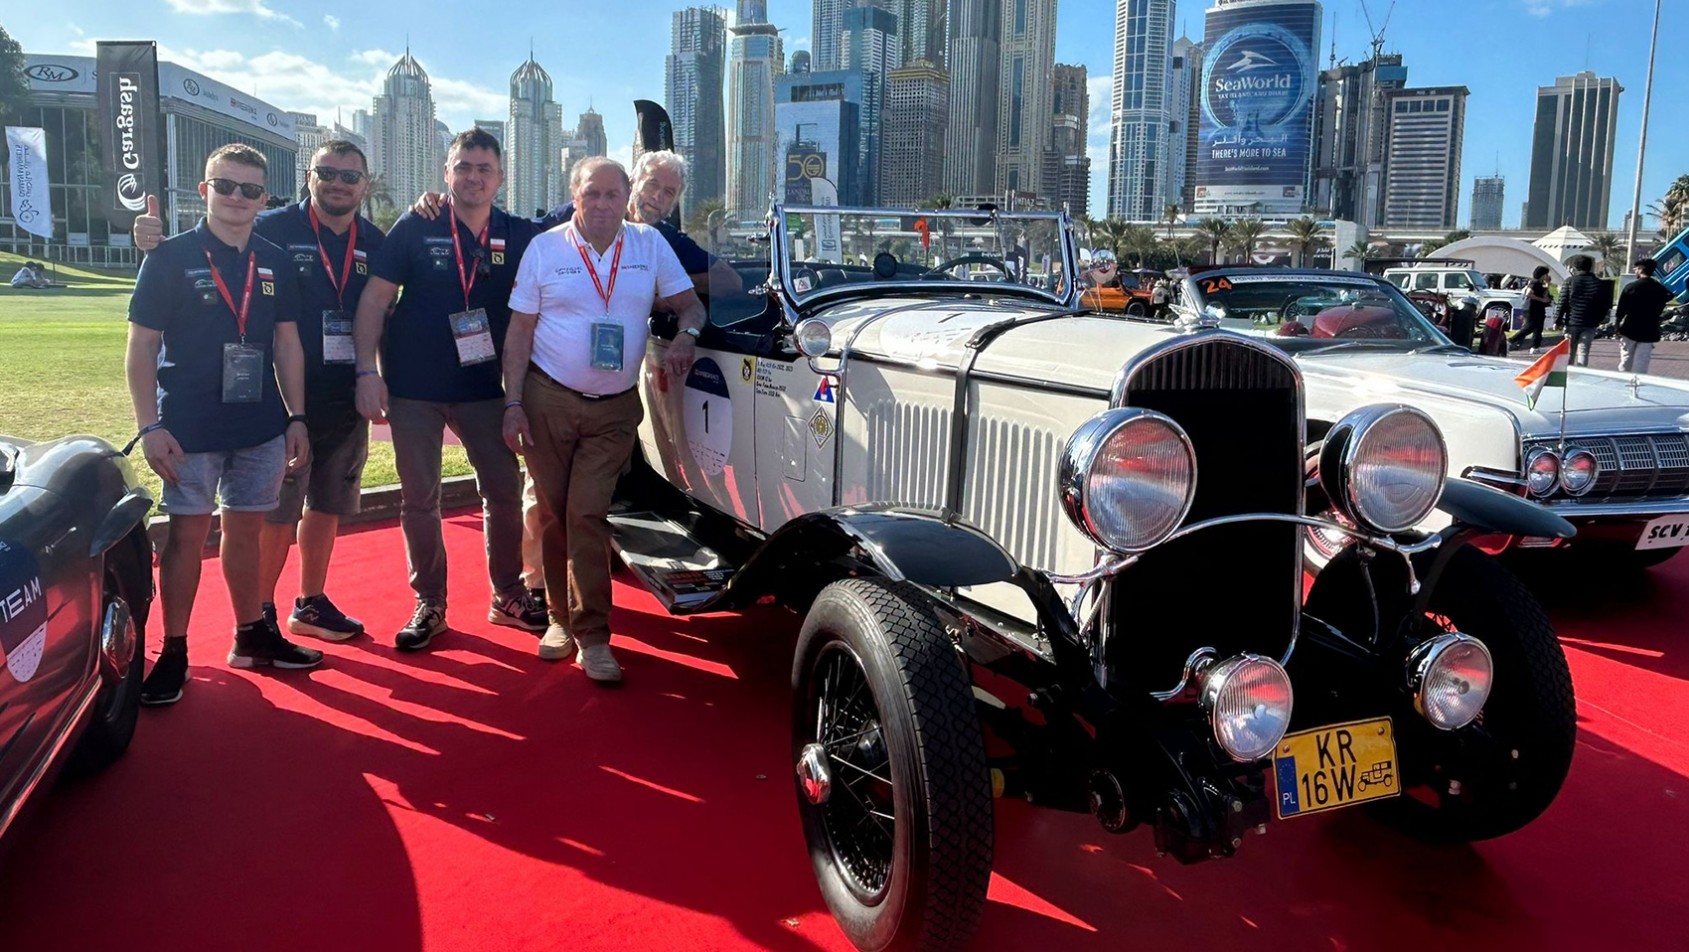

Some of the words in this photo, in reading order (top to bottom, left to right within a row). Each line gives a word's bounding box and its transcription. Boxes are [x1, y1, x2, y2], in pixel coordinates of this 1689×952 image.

[37, 66, 65, 80] RM
[1215, 74, 1291, 92] SeaWorld
[1211, 148, 1238, 159] THERE'S
[1239, 148, 1260, 158] MORE
[1261, 148, 1271, 157] TO
[1272, 147, 1287, 157] SEA
[1201, 278, 1233, 294] 24
[702, 400, 709, 434] 1
[1648, 523, 1684, 540] SCV
[0, 576, 42, 623] TEAM
[1315, 729, 1357, 769] KR
[1302, 764, 1356, 808] 16W
[1282, 792, 1296, 806] PL
